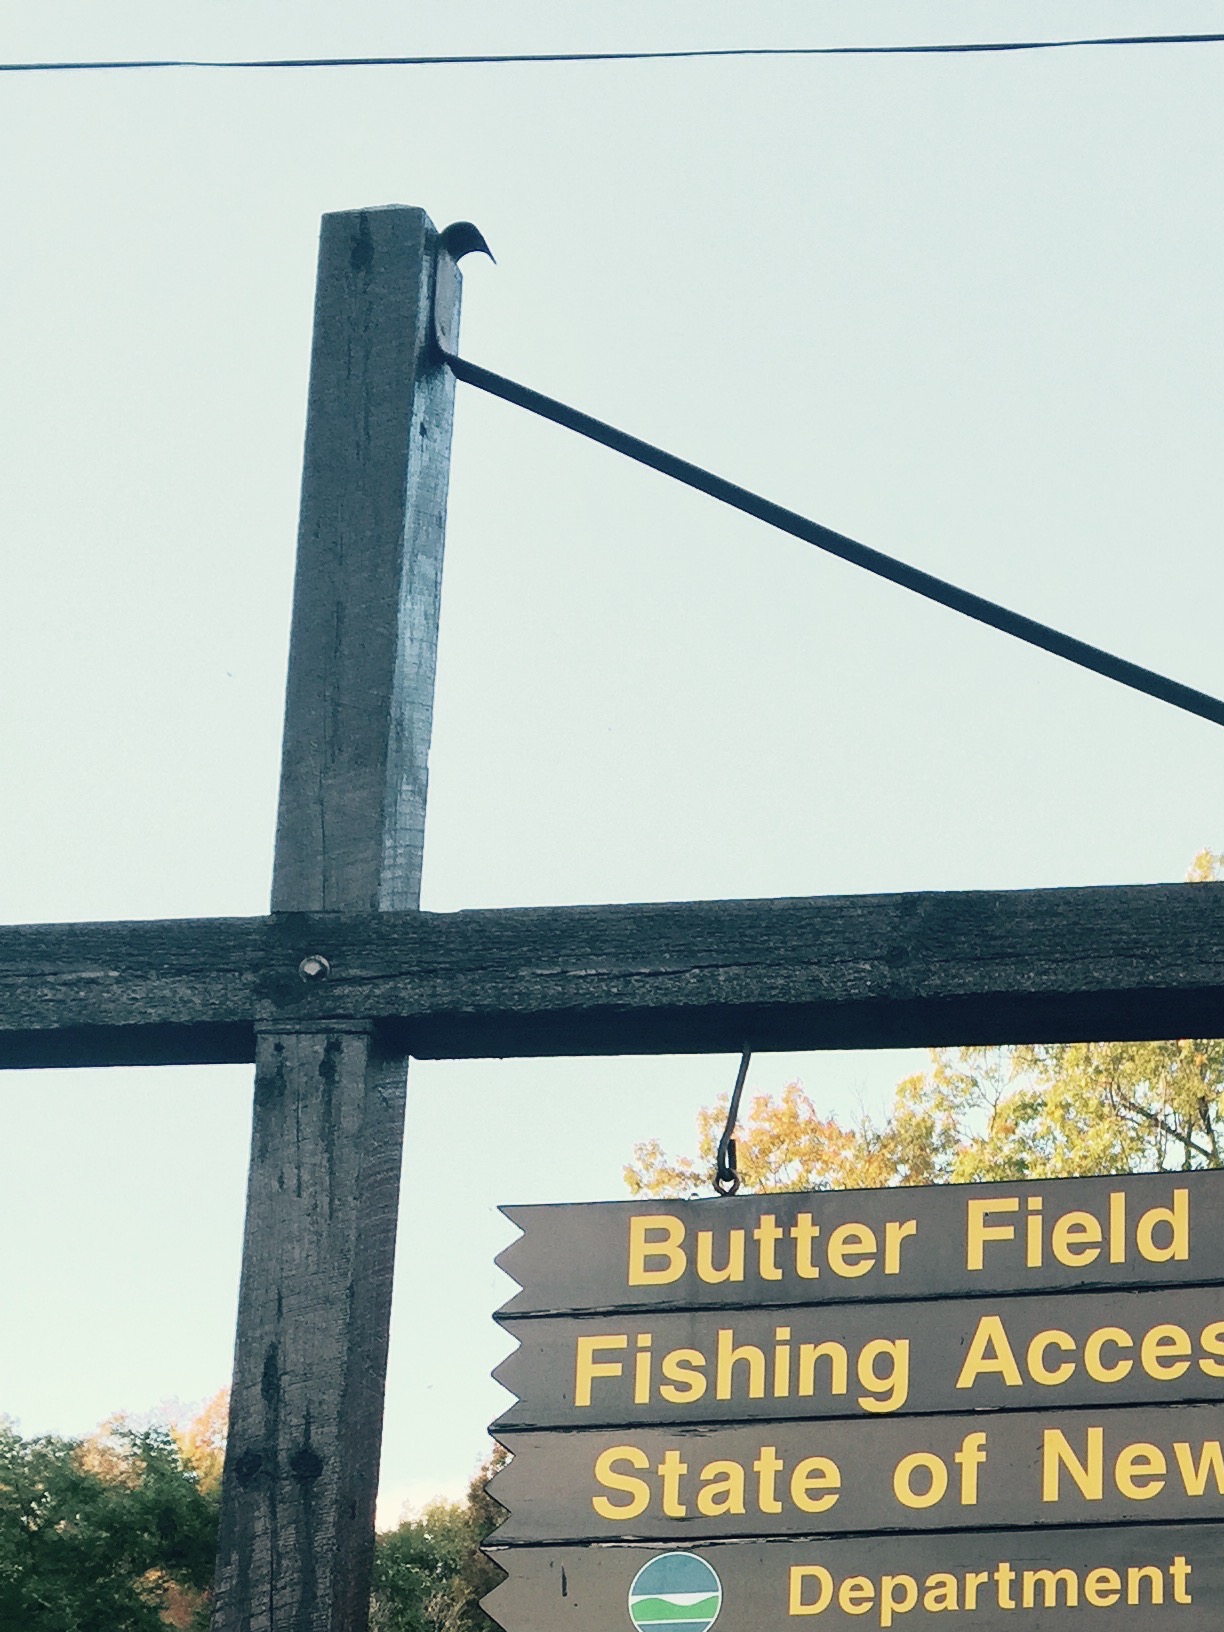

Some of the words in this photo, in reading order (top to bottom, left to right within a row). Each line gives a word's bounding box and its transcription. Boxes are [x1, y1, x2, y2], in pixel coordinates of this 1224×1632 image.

[627, 1212, 917, 1286] Butter
[966, 1188, 1189, 1271] Field
[574, 1326, 910, 1413] Fishing
[591, 1444, 842, 1521] State
[892, 1431, 987, 1509] of
[787, 1555, 1192, 1628] Department
